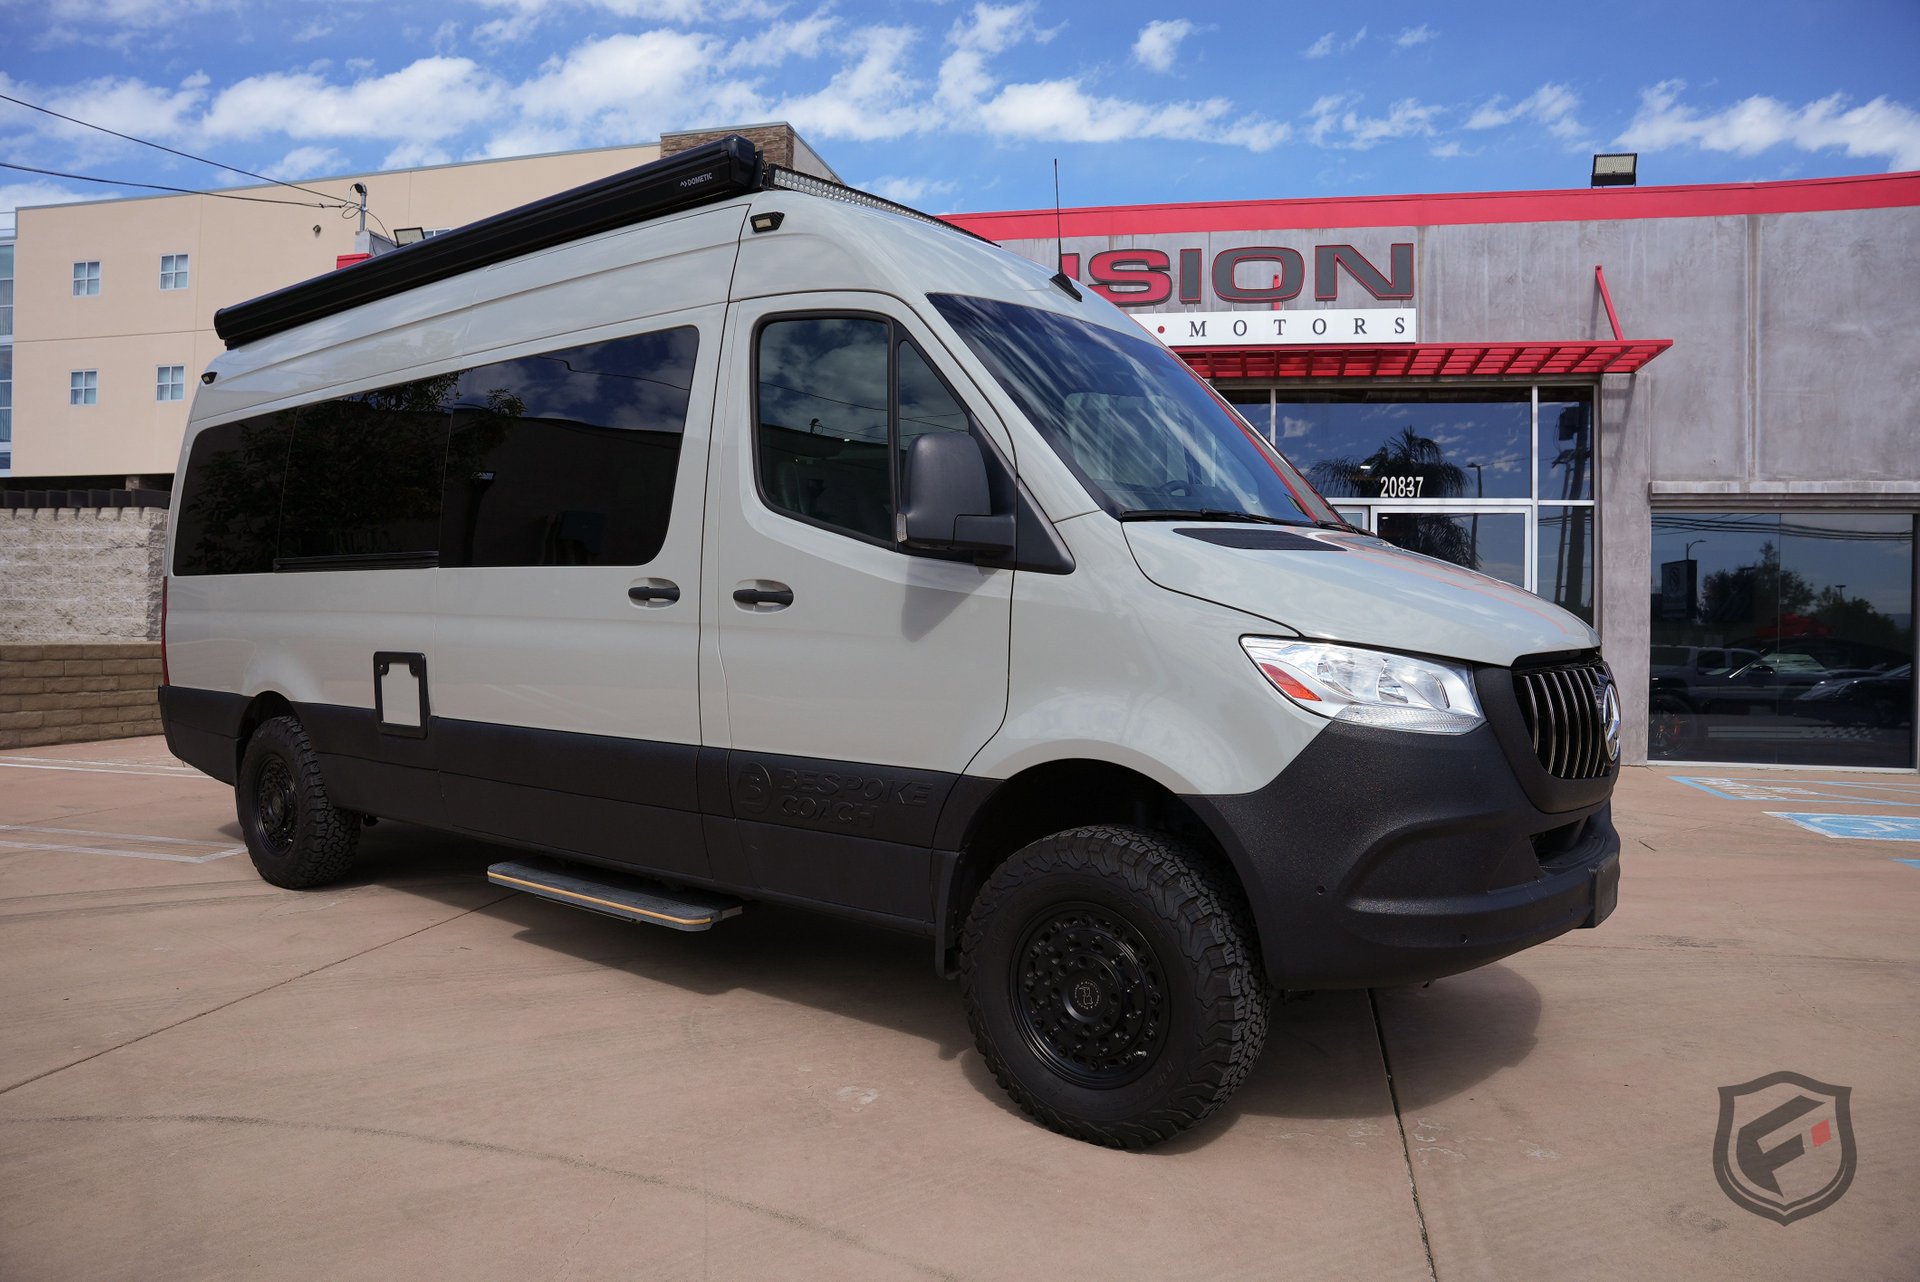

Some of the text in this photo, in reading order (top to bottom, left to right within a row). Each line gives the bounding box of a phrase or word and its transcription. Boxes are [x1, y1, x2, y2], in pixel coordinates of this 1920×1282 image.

[687, 172, 713, 187] DOMETIC
[1061, 243, 1415, 306] SION
[1188, 317, 1406, 338] MOTORS
[1380, 476, 1424, 498] 20837
[778, 767, 934, 809] BESPOKE
[780, 794, 881, 829] COACH
